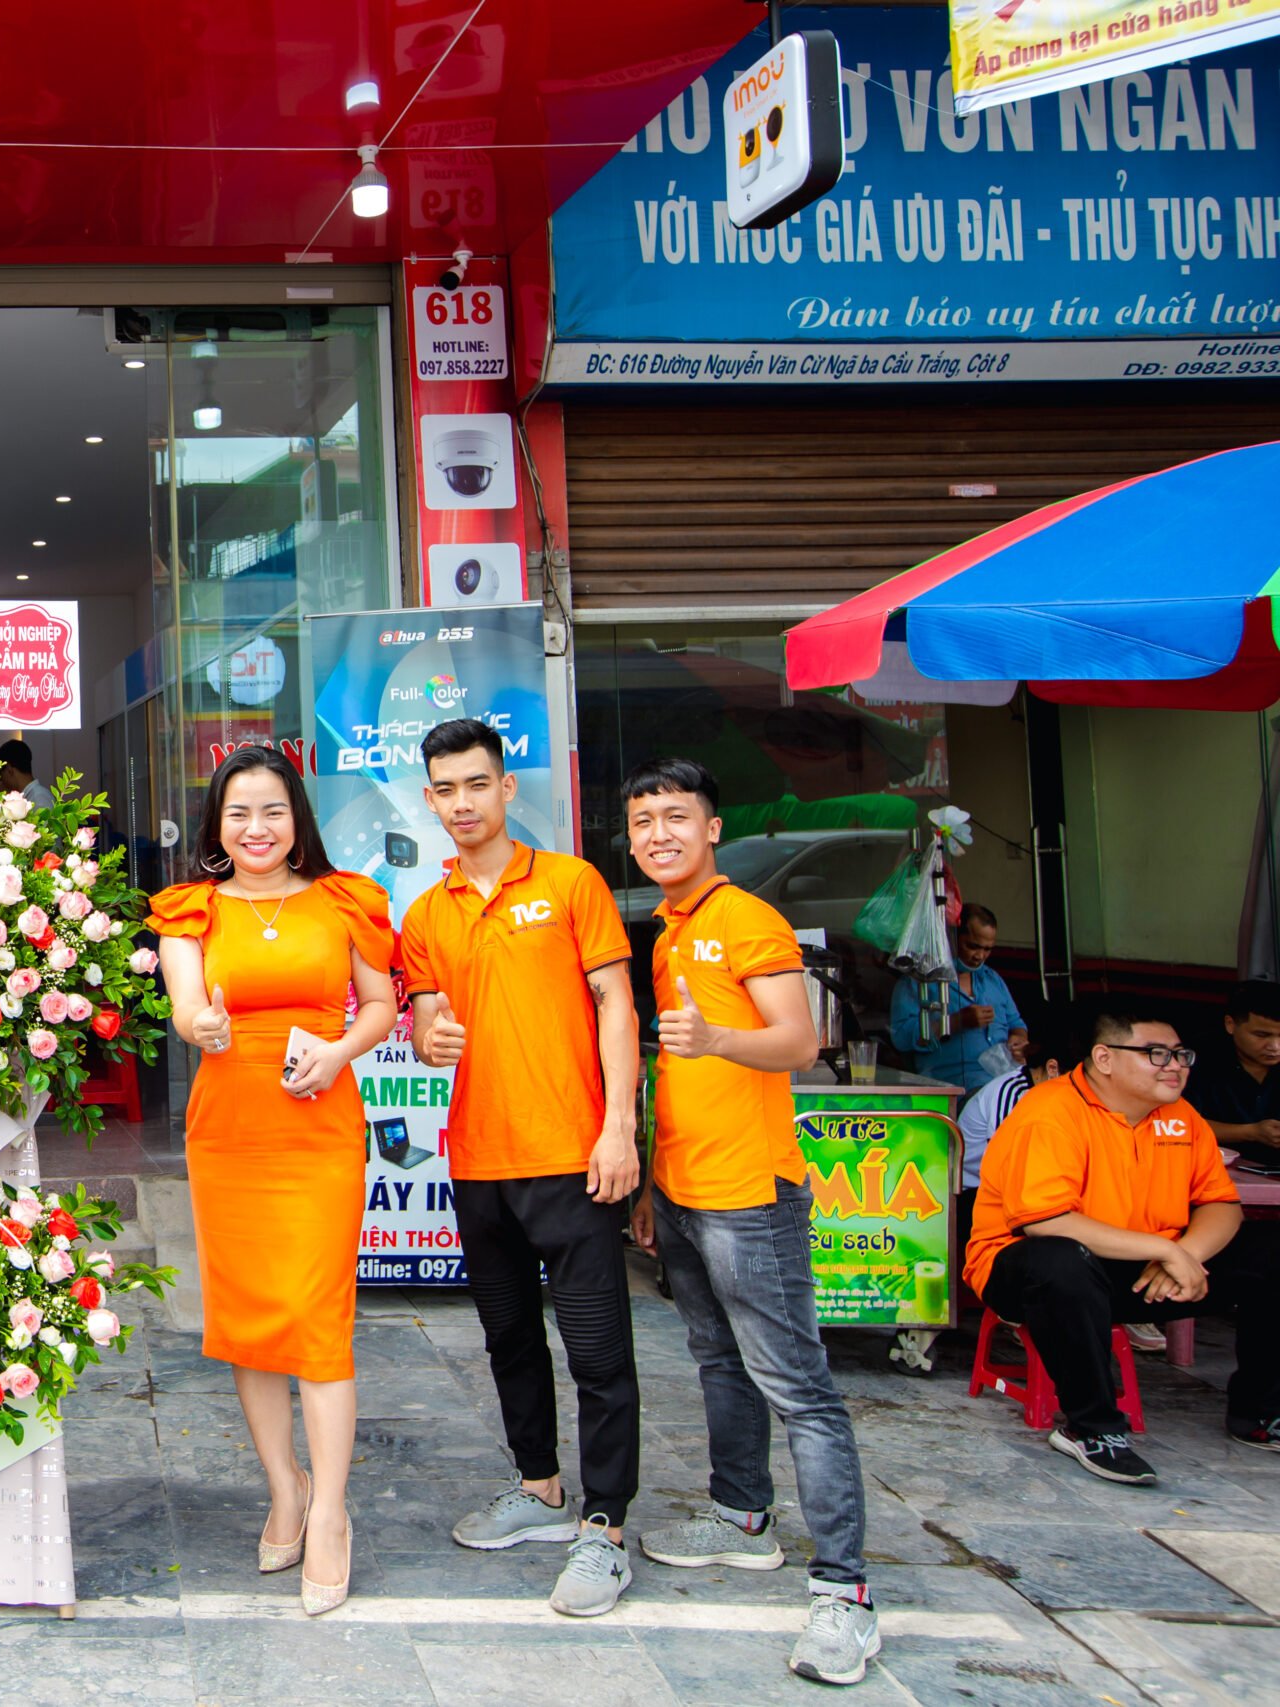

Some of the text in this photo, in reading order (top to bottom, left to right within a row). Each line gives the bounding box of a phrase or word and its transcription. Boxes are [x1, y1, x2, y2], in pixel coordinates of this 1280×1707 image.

[973, 51, 1001, 77] Áp
[1007, 37, 1062, 68] dụng
[1069, 23, 1099, 53] tại
[1107, 12, 1151, 41] cửa
[634, 183, 700, 264] VỚI
[815, 185, 883, 263] GIÁ
[893, 192, 946, 263] ƯU
[957, 184, 1025, 262] ĐÃI
[1062, 168, 1137, 262] THỦ
[1147, 196, 1223, 275] TỤC
[425, 291, 493, 325] 618
[787, 291, 1198, 333] Đảm bảo uy tín chất
[432, 340, 489, 353] HOTLINE:
[419, 359, 504, 375] 097.858.2227
[586, 350, 1011, 380] ĐC: 616 Đường Nguyễn Văn Cừ Ngã ba Cầu Trắng, Cột 8
[1123, 363, 1169, 376] DĐ:
[18, 622, 62, 644] NGHIỆP
[436, 626, 474, 642] DSS
[28, 641, 59, 670] PHẢ
[375, 1046, 406, 1063] TÂN
[807, 1147, 943, 1222] MÍA
[842, 1225, 897, 1256] sạch
